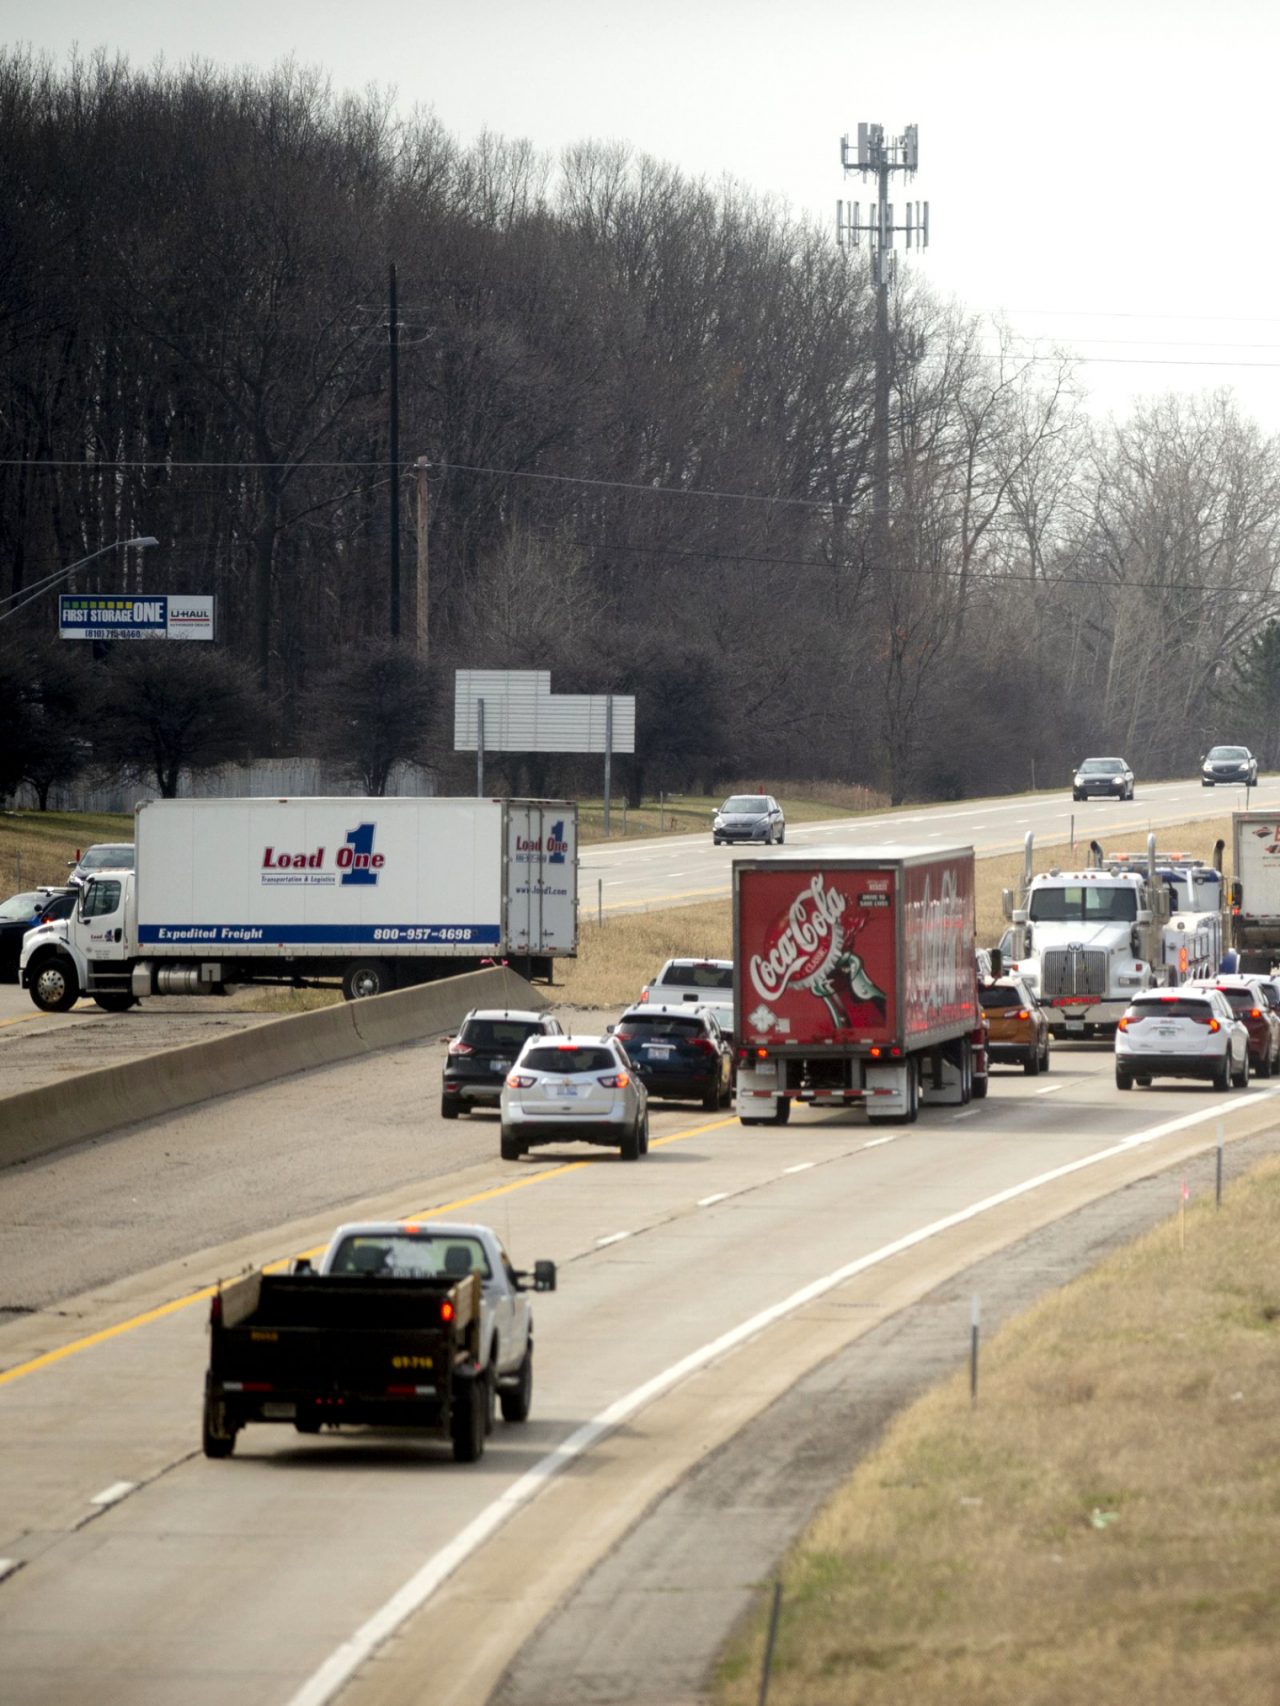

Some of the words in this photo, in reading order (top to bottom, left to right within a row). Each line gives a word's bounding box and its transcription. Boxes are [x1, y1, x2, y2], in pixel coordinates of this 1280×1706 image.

[63, 609, 89, 622] FIRST
[91, 609, 133, 622] STORAGE
[133, 602, 164, 622] ONE
[170, 610, 209, 618] U-HAUL
[516, 836, 542, 851] Load
[547, 837, 568, 852] One
[262, 848, 325, 868] Load
[336, 847, 385, 868] One
[261, 875, 302, 883] Transportation
[158, 928, 217, 939] Expedited
[221, 928, 264, 940] Freight
[374, 928, 472, 940] 800-957-4698
